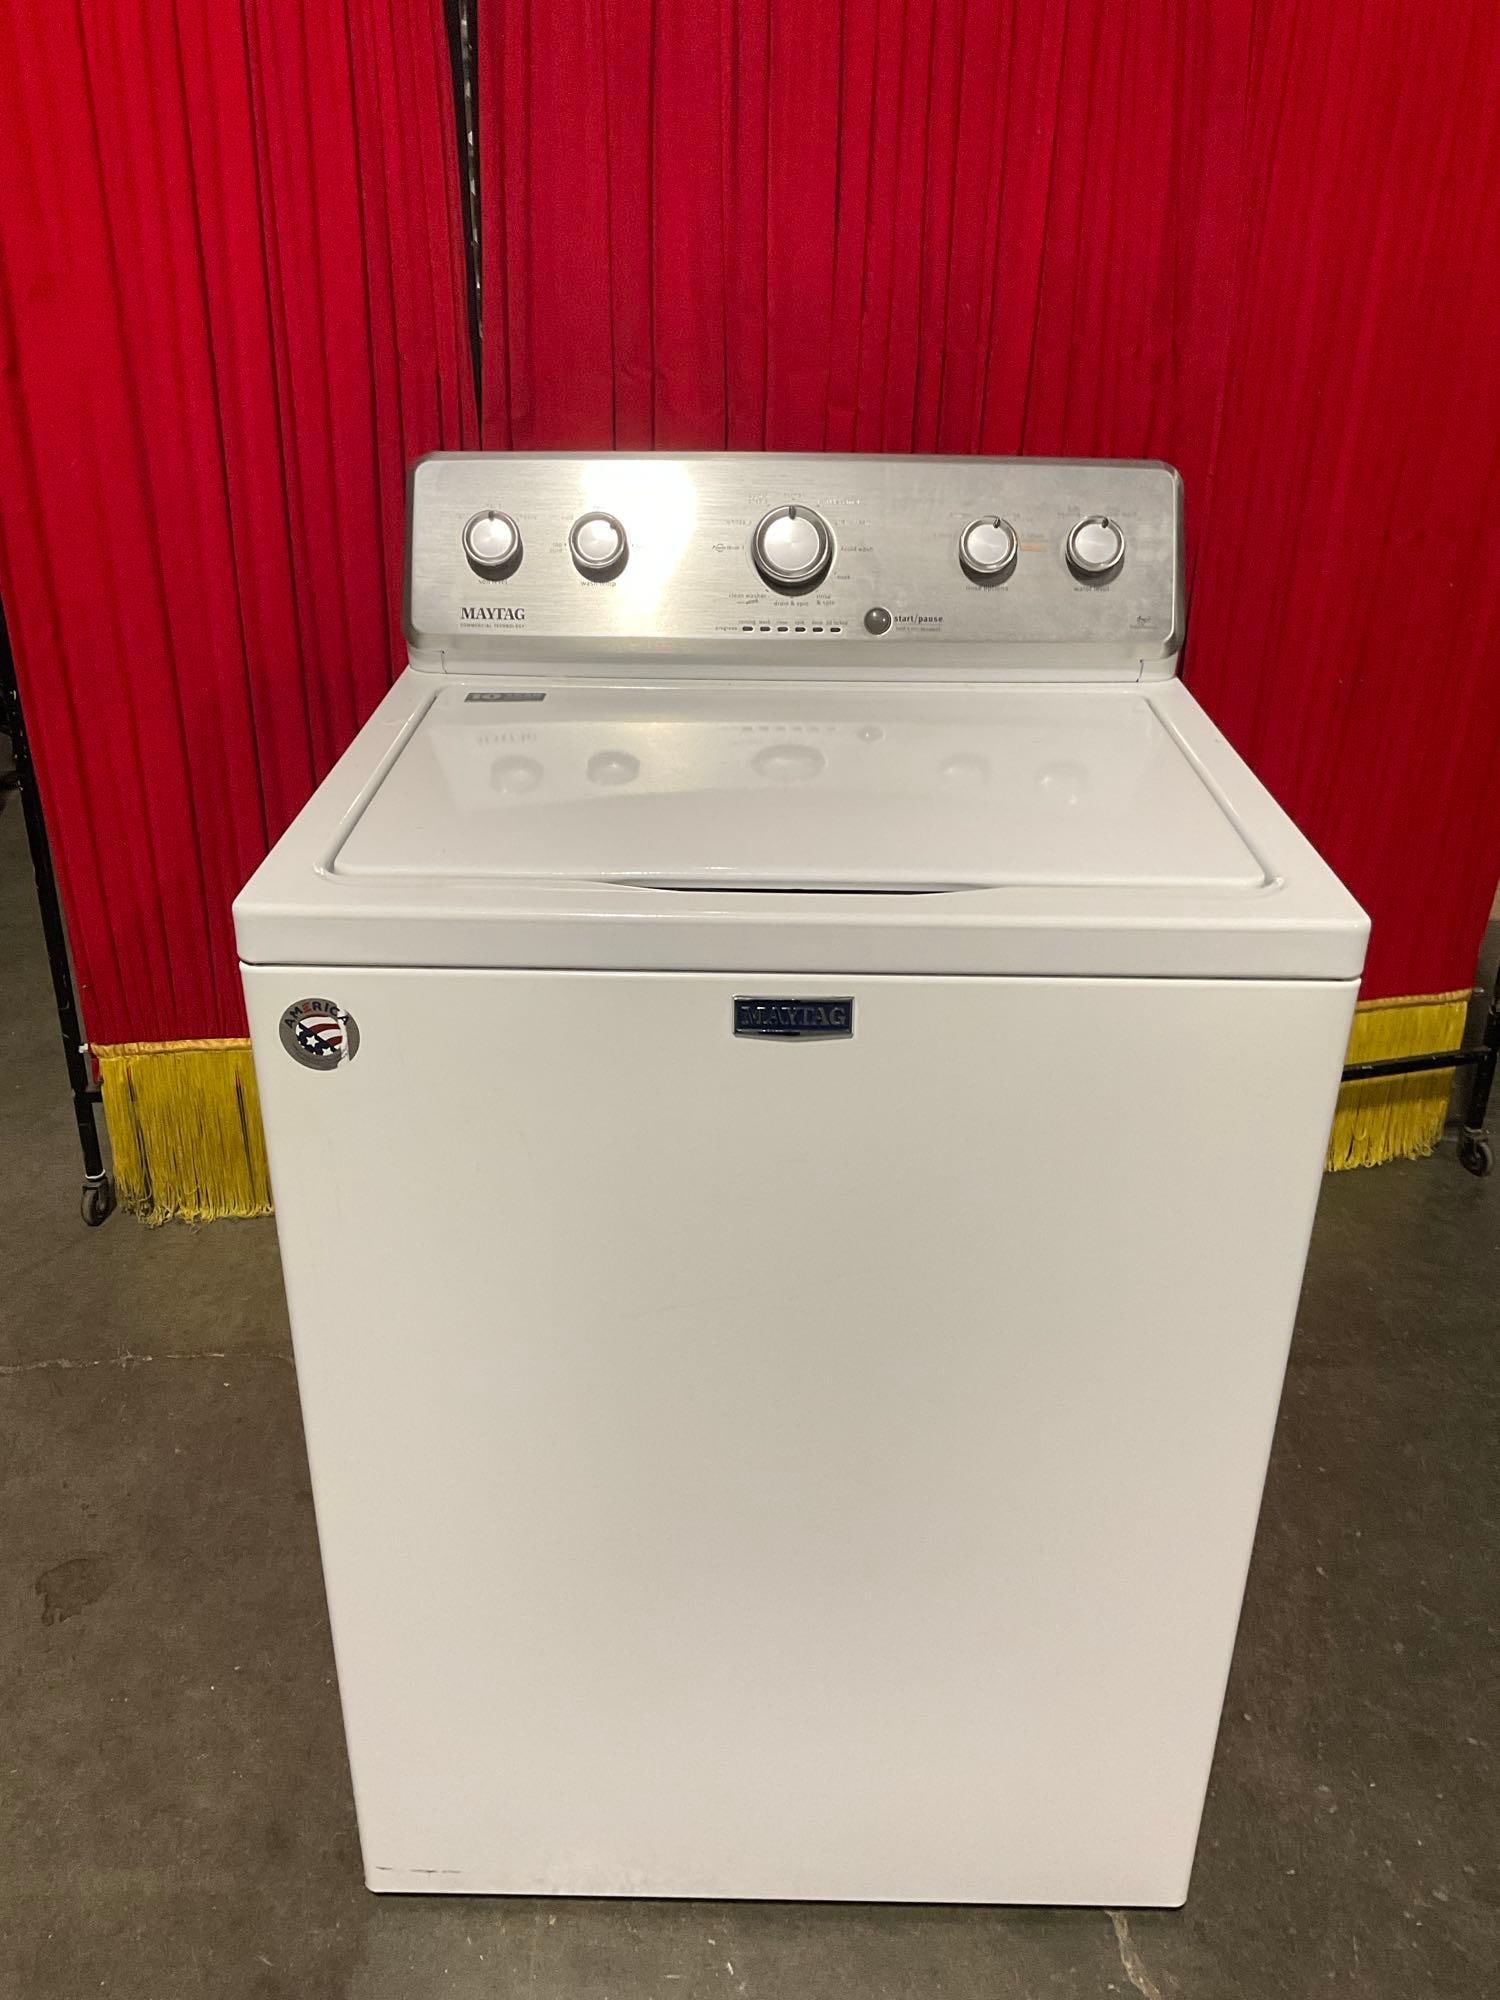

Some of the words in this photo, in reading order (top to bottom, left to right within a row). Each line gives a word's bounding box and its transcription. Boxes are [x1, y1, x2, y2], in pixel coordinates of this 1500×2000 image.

[461, 607, 525, 620] MAYTAG
[893, 613, 944, 625] start/pause
[284, 1001, 349, 1029] AMERICA
[740, 1006, 847, 1026] MAYTAG
